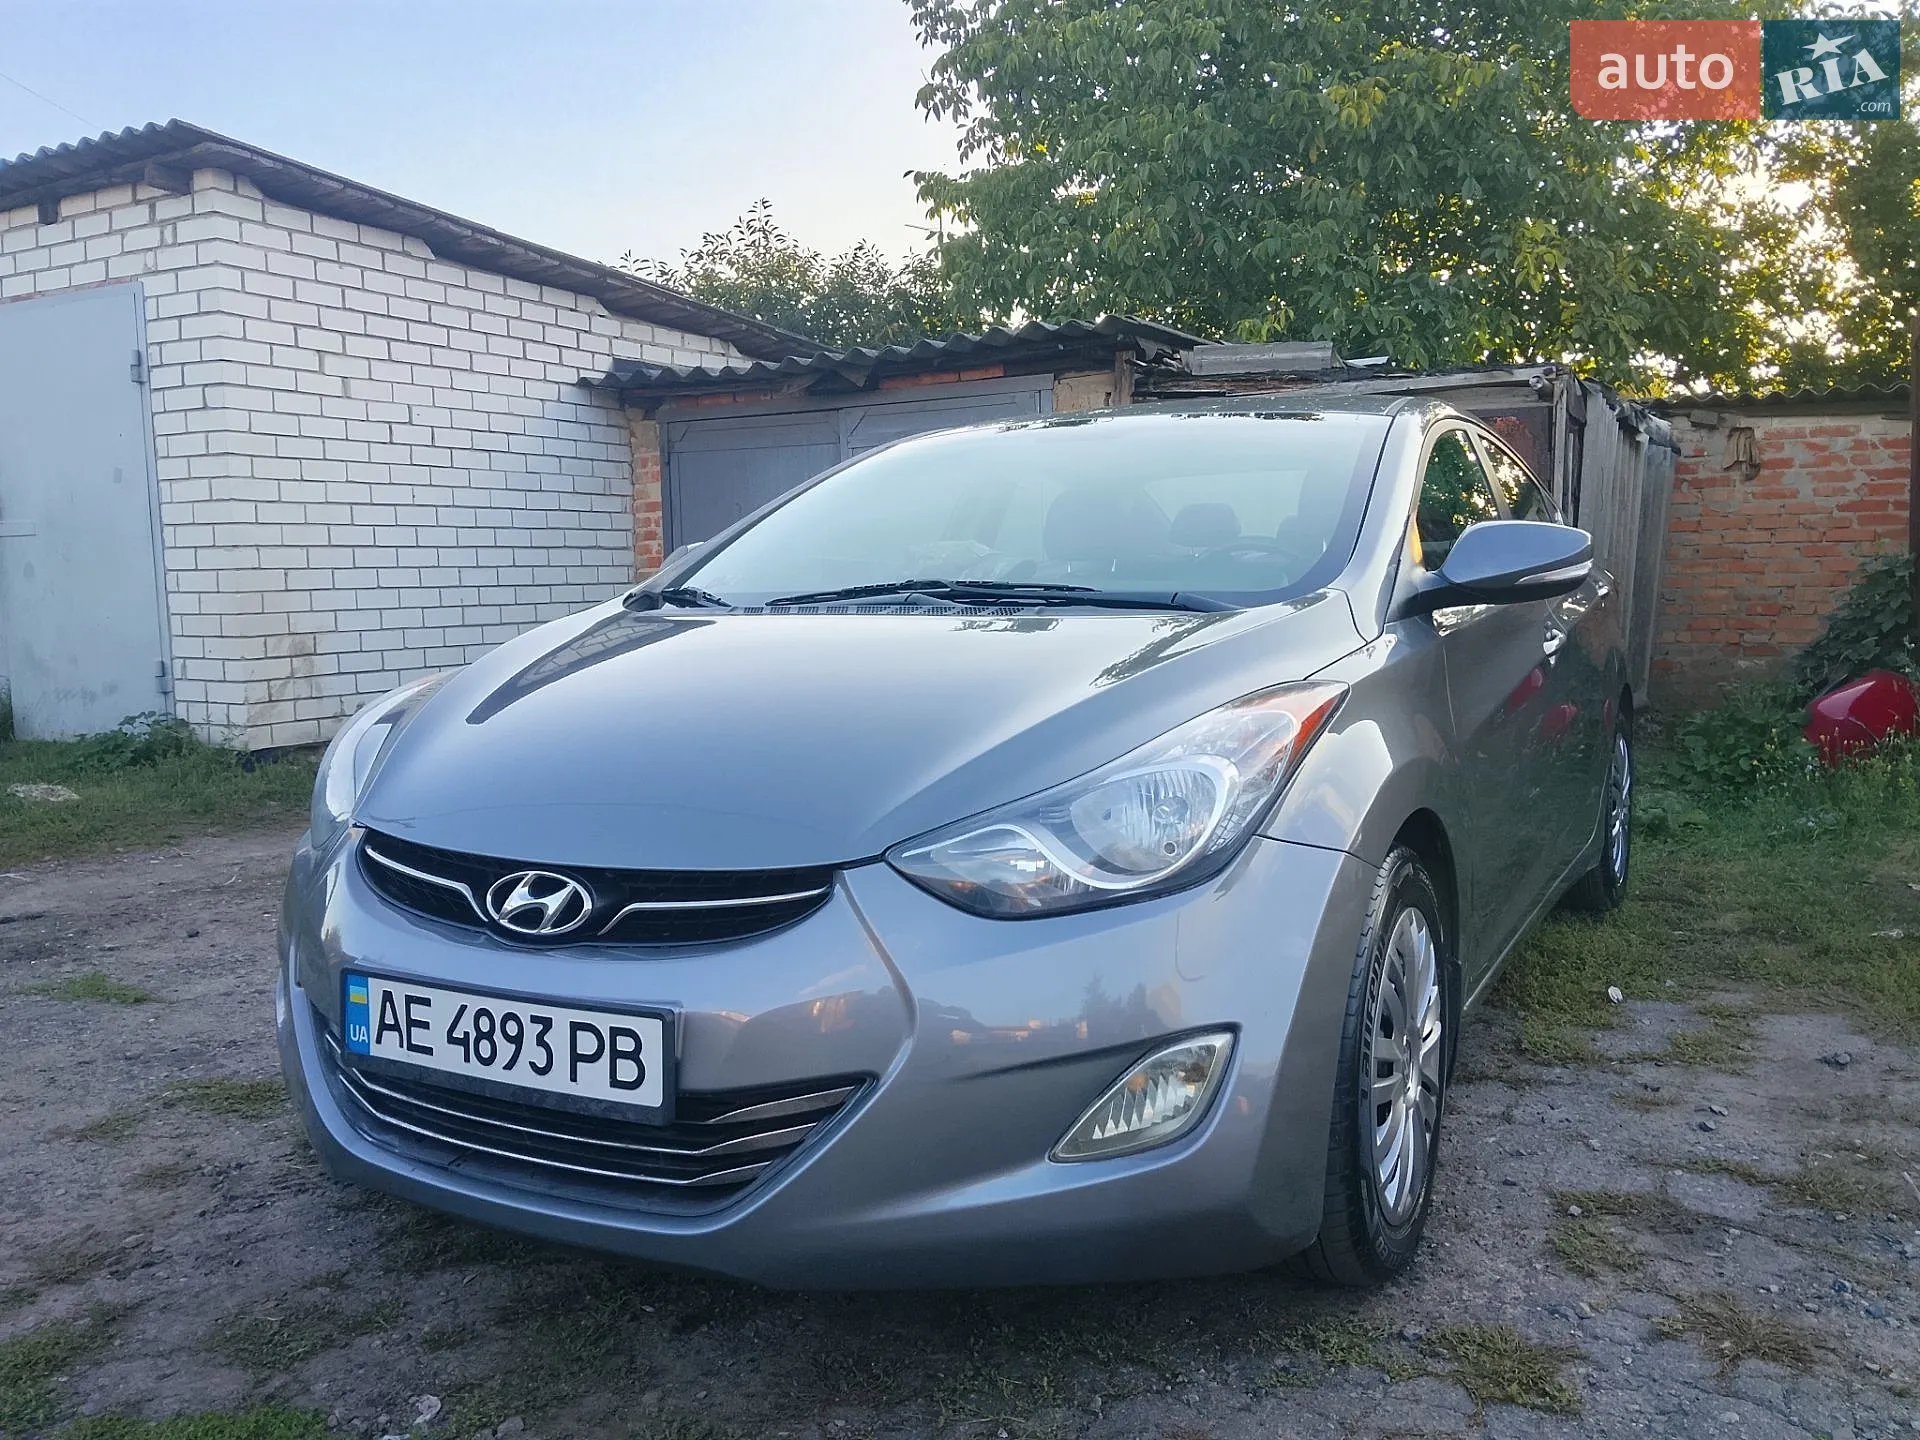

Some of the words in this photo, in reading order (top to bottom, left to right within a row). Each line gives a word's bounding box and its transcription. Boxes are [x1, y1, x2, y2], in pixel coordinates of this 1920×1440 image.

[350, 1023, 369, 1044] UA
[375, 989, 434, 1056] AE
[446, 1003, 554, 1076] 4893
[569, 1020, 646, 1091] PB
